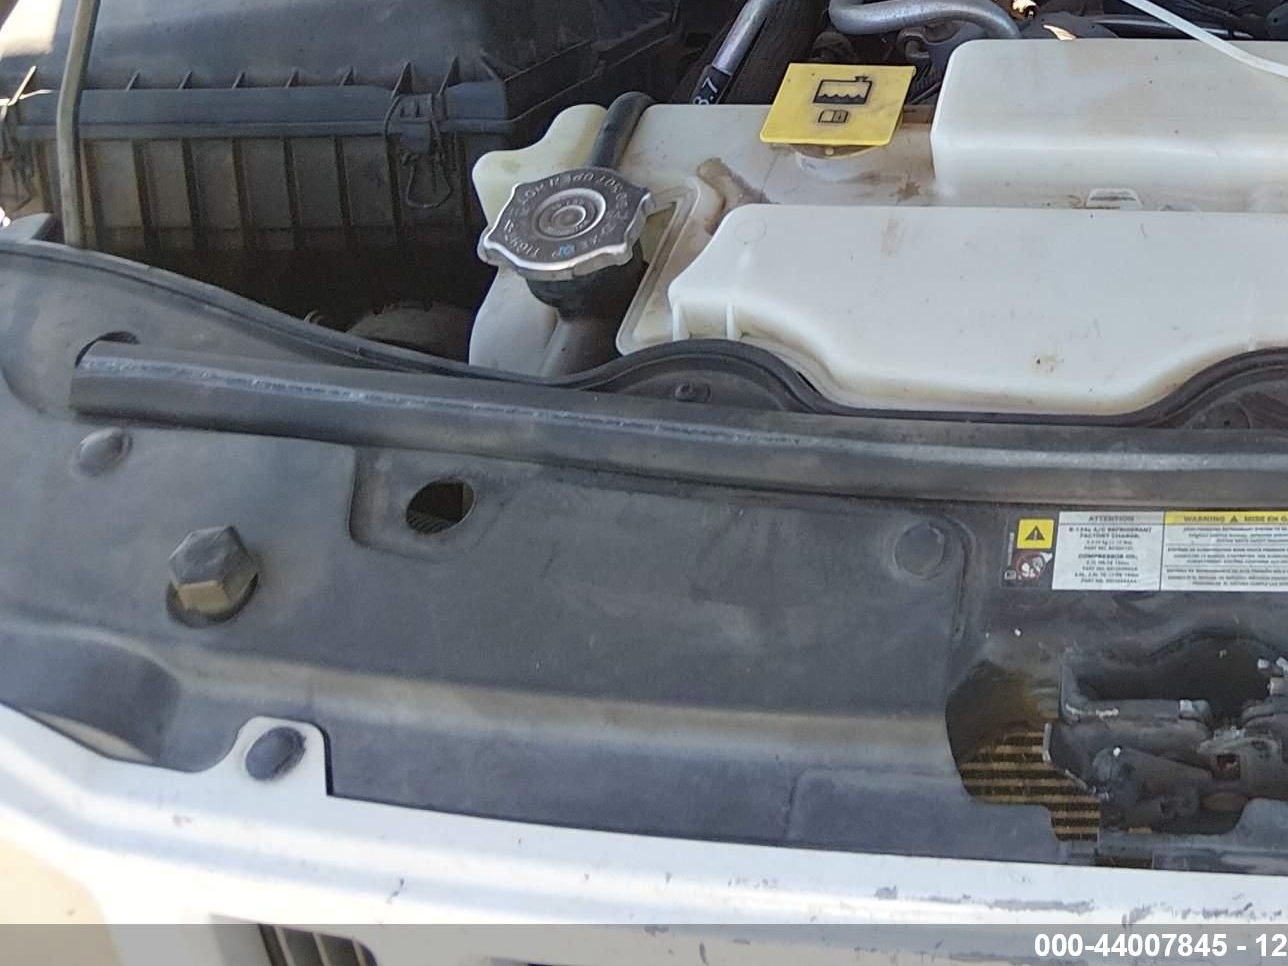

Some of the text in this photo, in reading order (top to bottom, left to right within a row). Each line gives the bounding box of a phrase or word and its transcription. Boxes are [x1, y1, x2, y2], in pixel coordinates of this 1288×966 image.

[1183, 514, 1226, 522] WARNING
[1244, 514, 1265, 522] MISE
[1267, 514, 1278, 522] EN
